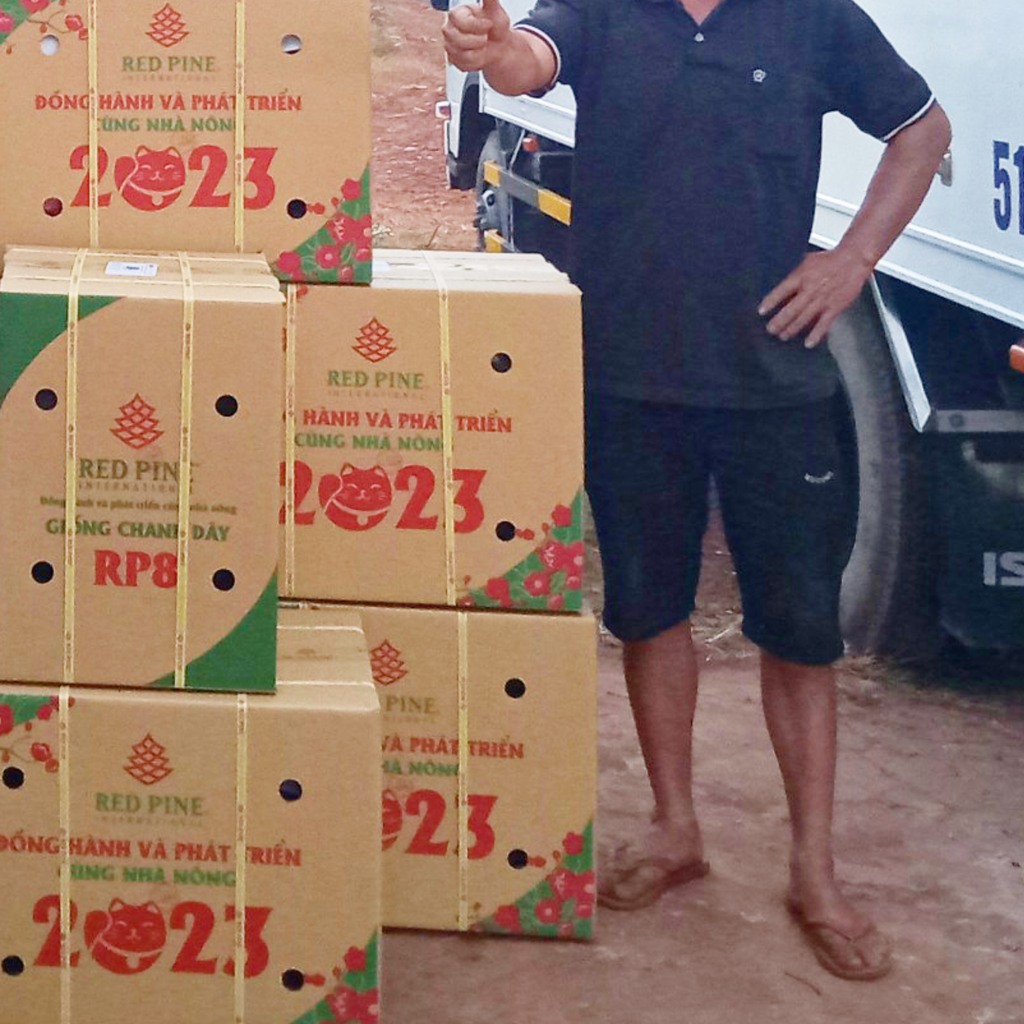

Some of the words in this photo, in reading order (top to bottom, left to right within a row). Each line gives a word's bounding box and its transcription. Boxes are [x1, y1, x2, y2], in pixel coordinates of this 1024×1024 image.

[122, 56, 162, 72] RED
[168, 56, 216, 73] PINE
[328, 370, 368, 387] RED
[376, 371, 424, 389] PINE
[80, 458, 127, 480] RED
[118, 521, 180, 539] CHAN
[93, 549, 178, 589] RP8
[95, 792, 140, 813] RED
[148, 794, 203, 816] PINE
